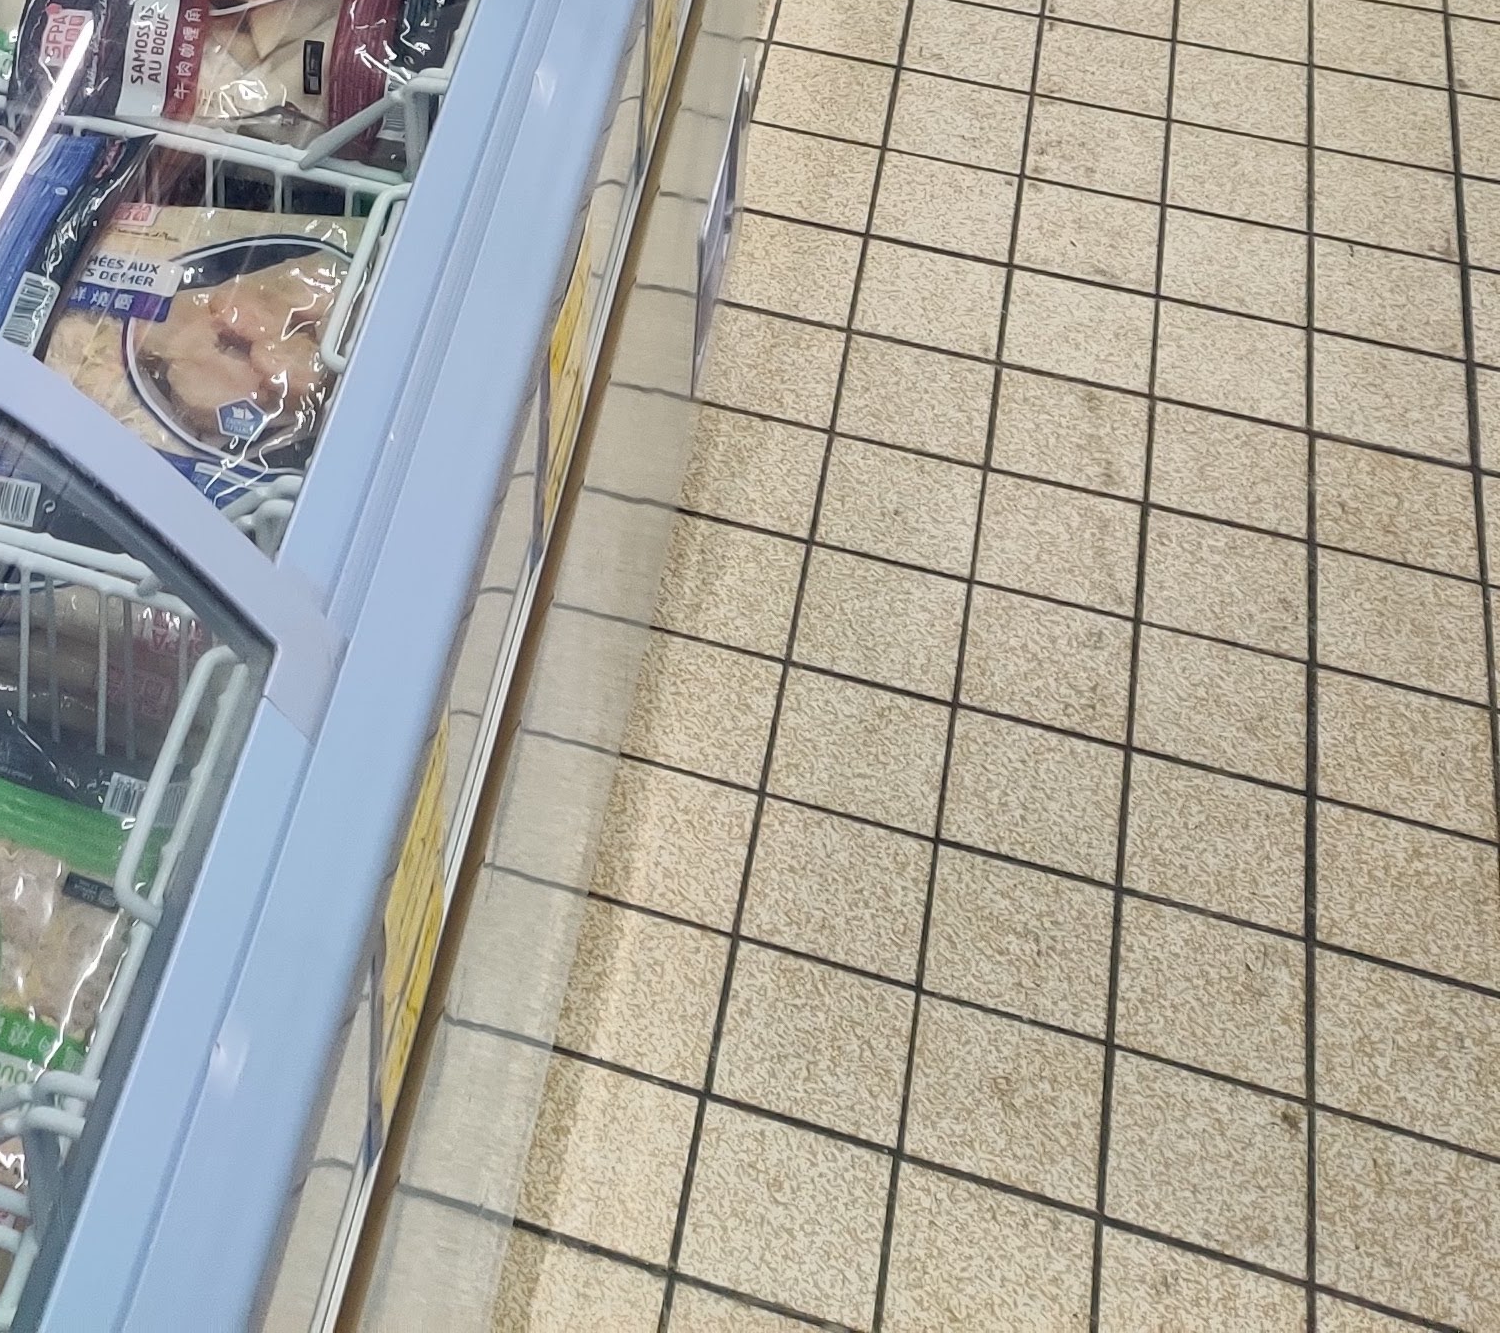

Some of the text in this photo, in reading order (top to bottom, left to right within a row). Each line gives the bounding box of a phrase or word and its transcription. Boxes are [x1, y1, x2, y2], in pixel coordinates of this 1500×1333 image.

[147, 12, 170, 84] AU BOEUF
[128, 260, 162, 276] AUX
